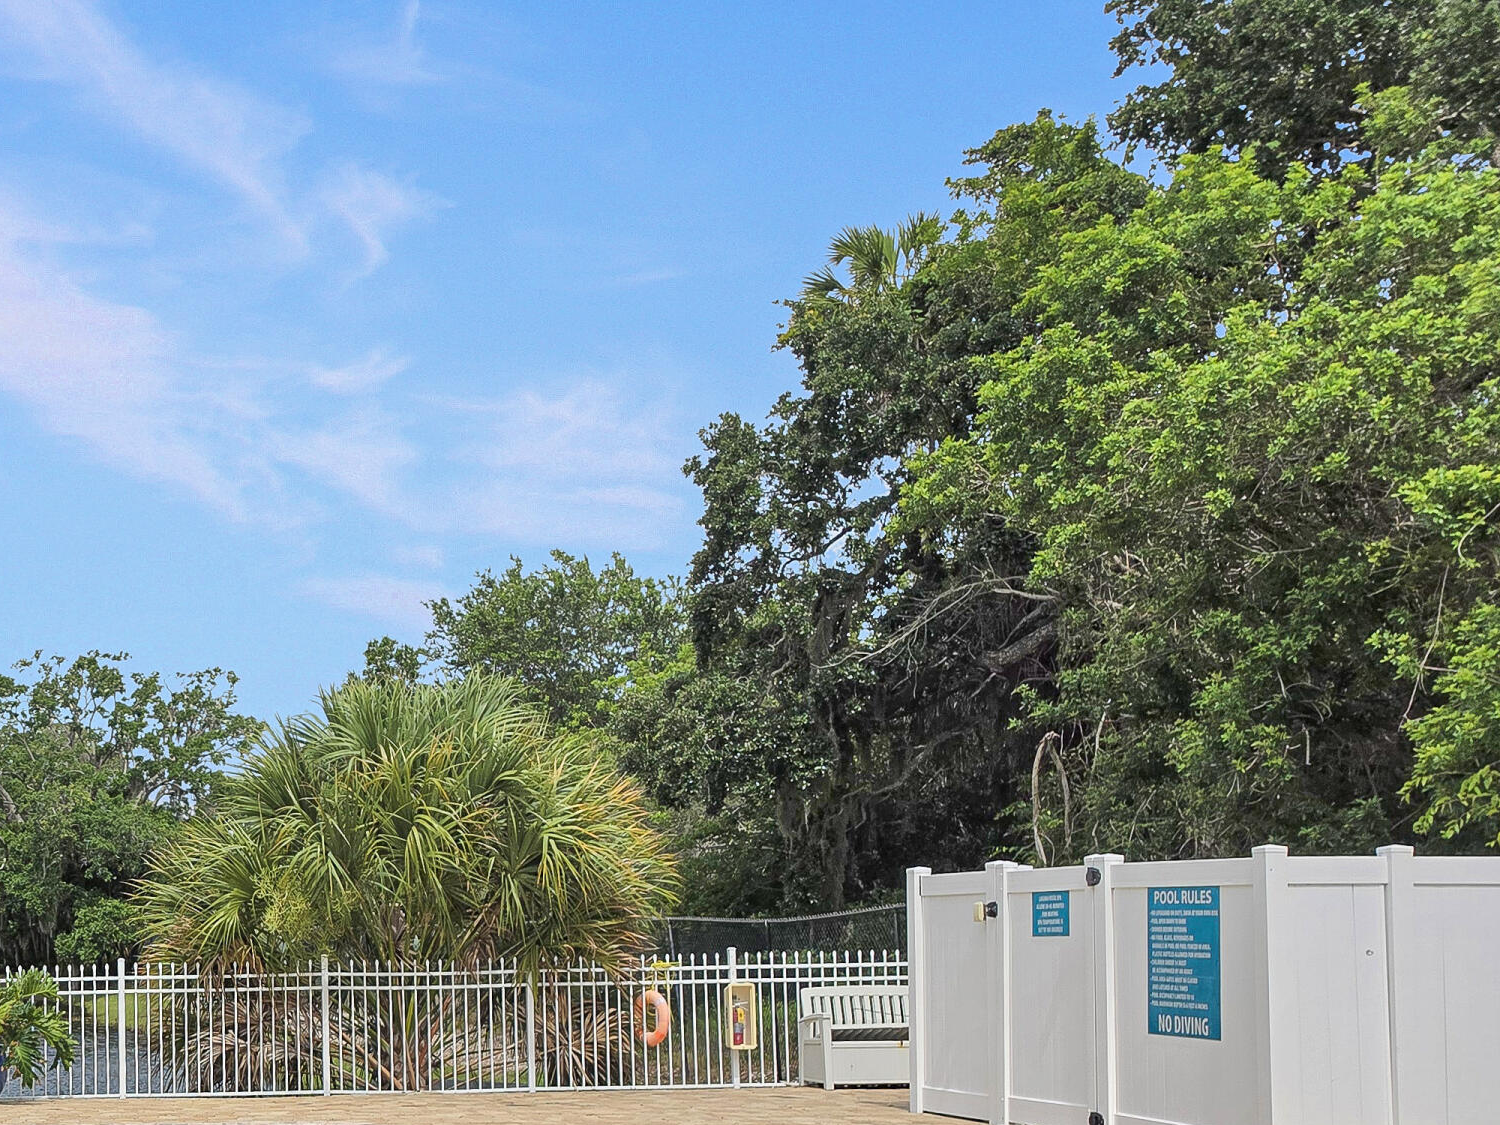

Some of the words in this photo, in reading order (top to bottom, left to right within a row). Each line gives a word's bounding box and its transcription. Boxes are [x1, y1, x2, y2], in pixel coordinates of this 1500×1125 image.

[1153, 890, 1180, 904] POOL
[1181, 889, 1212, 904] RULES
[1158, 1014, 1172, 1033] NO
[1174, 1015, 1209, 1036] DIVING
